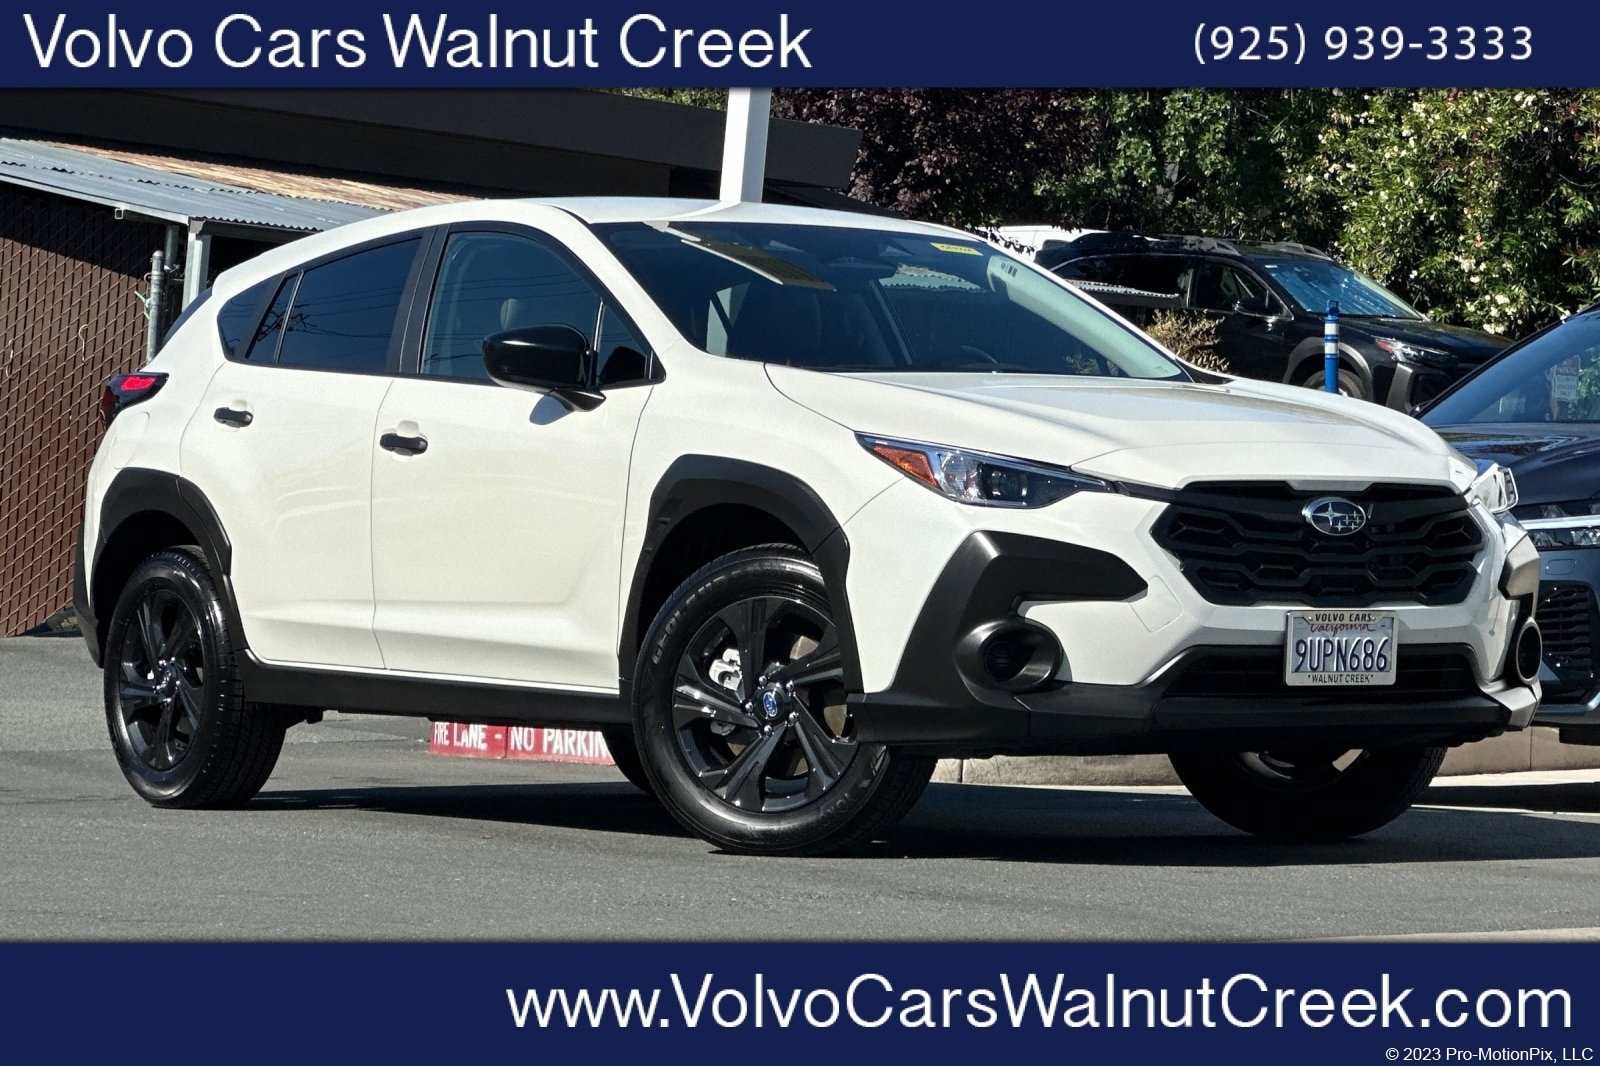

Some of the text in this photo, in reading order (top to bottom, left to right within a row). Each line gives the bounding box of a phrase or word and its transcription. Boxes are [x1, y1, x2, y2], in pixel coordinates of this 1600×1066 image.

[1315, 613, 1372, 622] VOLVO CARS
[1295, 637, 1389, 672] 9UPN686
[1345, 674, 1370, 683] CREEK
[453, 722, 488, 750] LANE
[510, 726, 534, 751] NO
[543, 728, 609, 758] PARKIN
